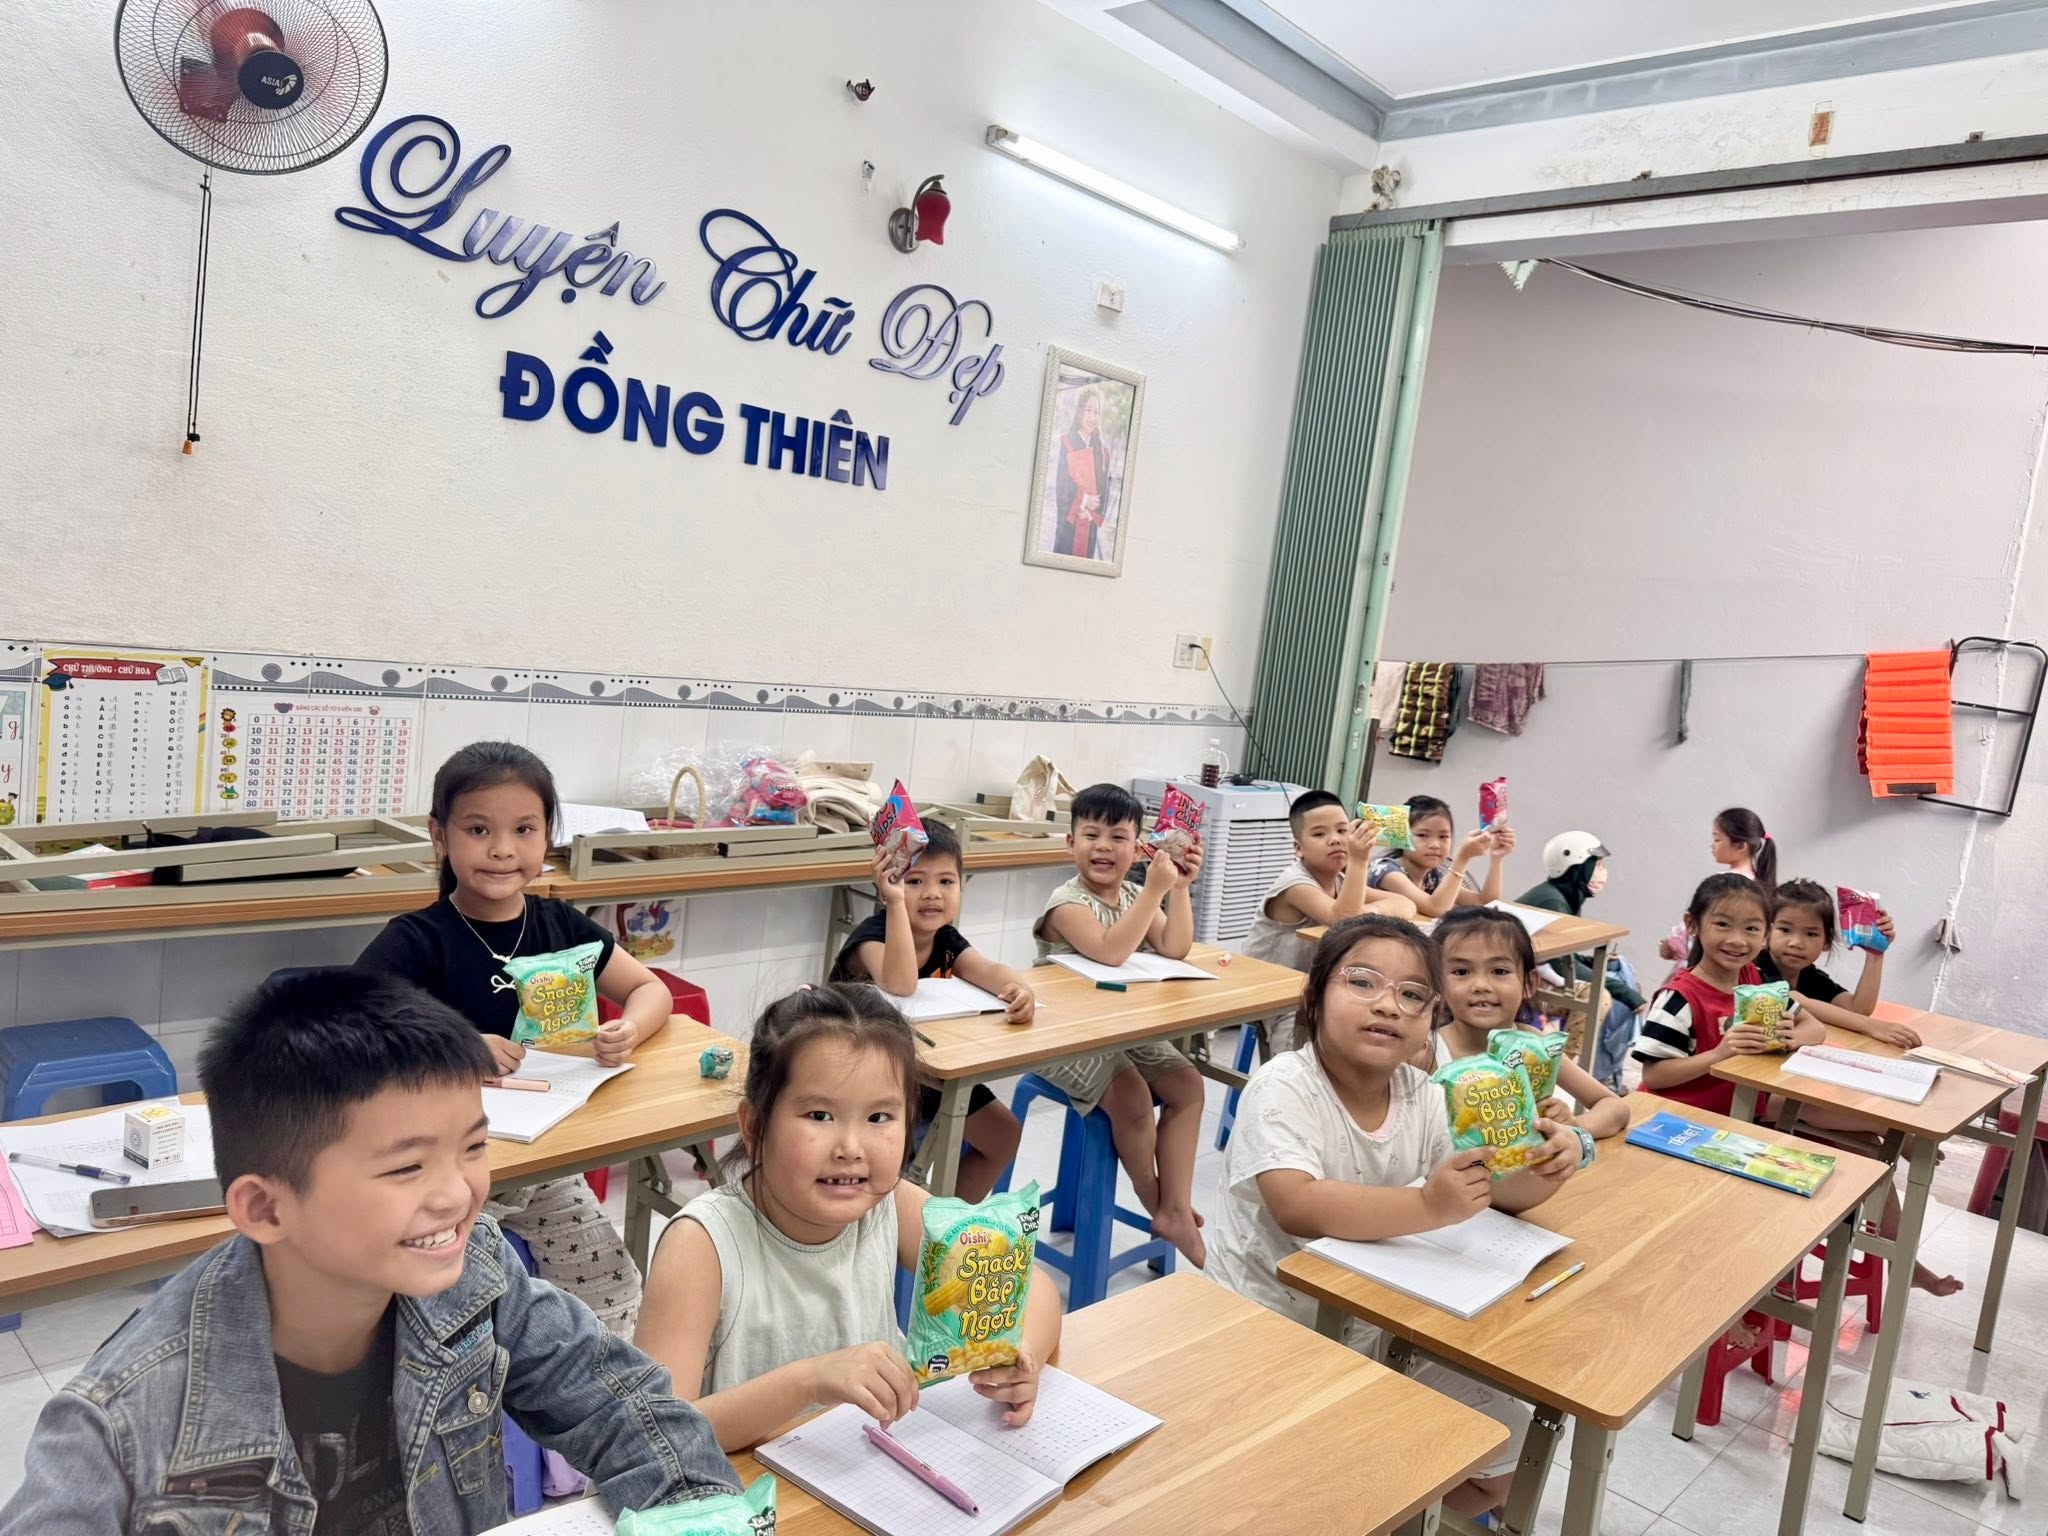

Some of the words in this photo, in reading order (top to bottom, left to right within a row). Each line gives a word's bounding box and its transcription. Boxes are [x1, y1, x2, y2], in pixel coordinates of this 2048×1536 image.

[260, 76, 280, 87] ASIA
[335, 114, 667, 319] Luyện
[699, 208, 853, 355] Chữ
[868, 283, 1005, 425] Đẹp
[500, 330, 725, 455] ĐỒNG
[740, 403, 890, 491] THIÊN
[63, 662, 80, 672] CHỮ
[118, 665, 134, 674] CHỮ
[135, 667, 151, 675] HOA
[252, 727, 262, 735] 10
[269, 727, 279, 735] 11
[268, 737, 278, 745] 21
[250, 747, 261, 755] 30
[285, 747, 295, 755] 32
[301, 747, 311, 755] 33
[333, 747, 343, 756] 35
[266, 758, 277, 766] 41
[248, 768, 260, 777] 50
[266, 768, 276, 776] 51
[283, 768, 294, 776] 52
[299, 768, 309, 776] 53
[331, 768, 342, 776] 55
[247, 779, 259, 787] 60
[264, 789, 274, 797] 71
[362, 787, 372, 795] 77
[246, 800, 257, 808] 80
[361, 797, 371, 805] 87
[296, 808, 306, 817] 93
[328, 808, 339, 816] 95
[533, 981, 586, 1002] Snack
[1465, 1079, 1522, 1106] Snack
[960, 1232, 988, 1246] Oishi
[958, 1248, 1027, 1280] Snack
[970, 1276, 1014, 1306] Bắp
